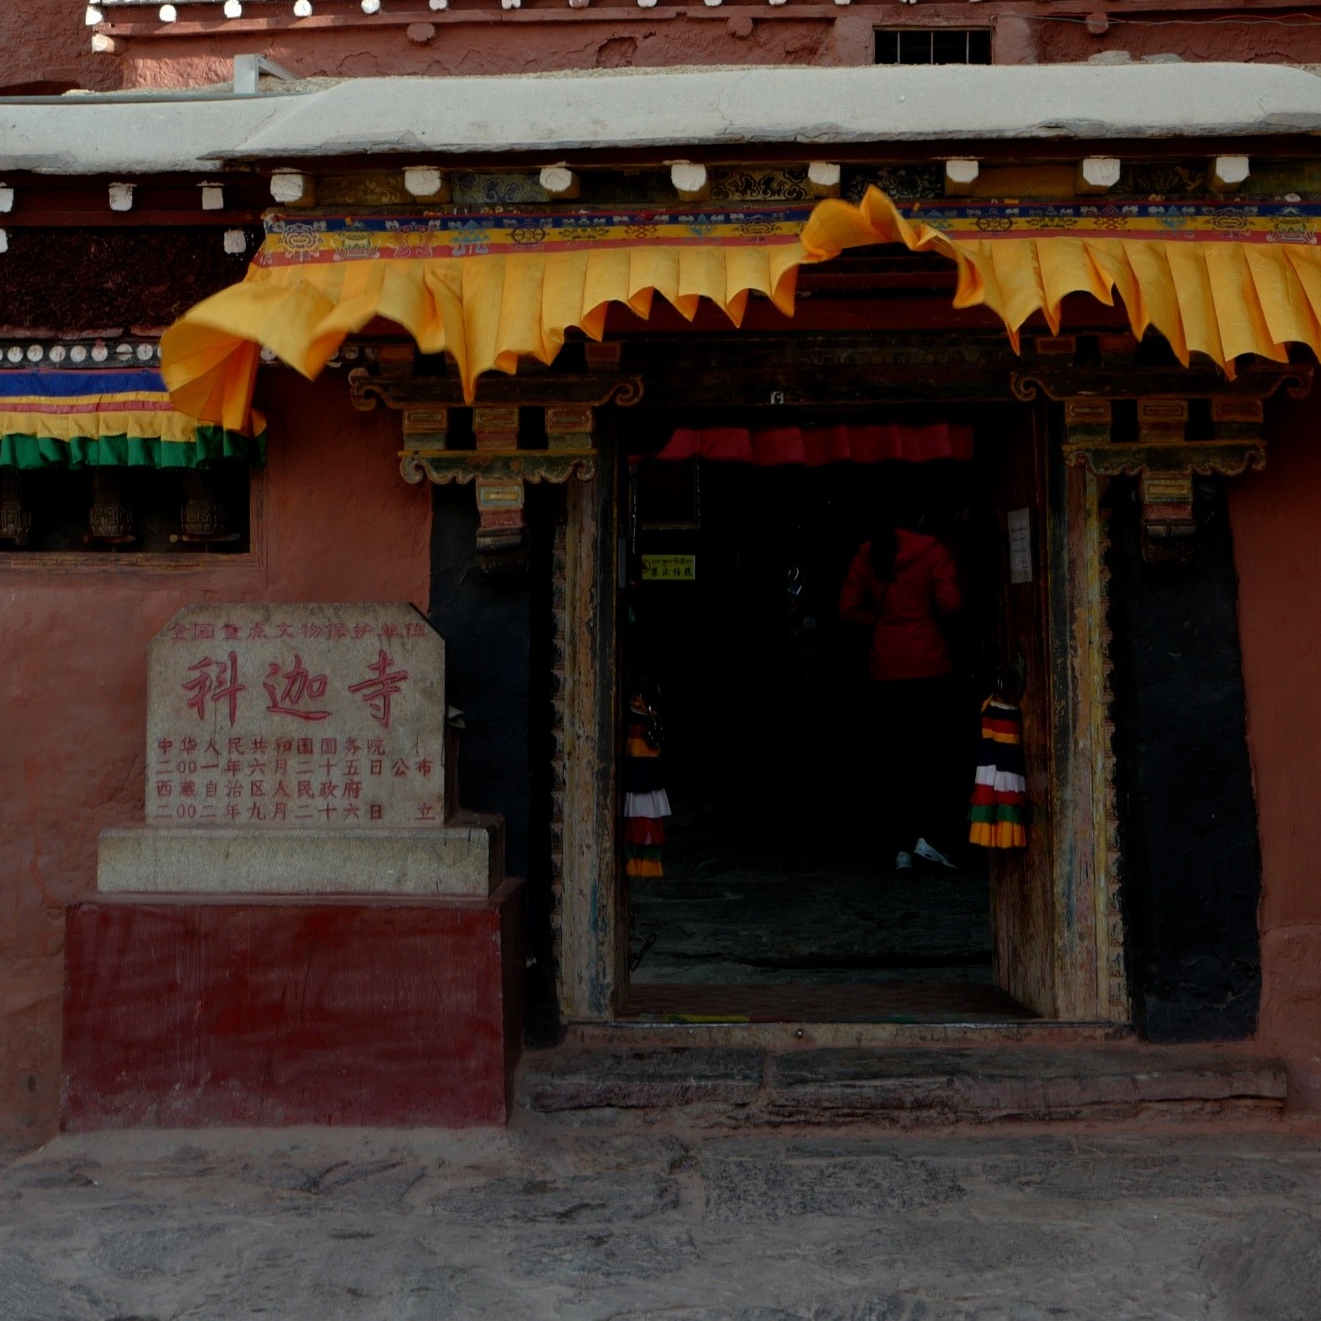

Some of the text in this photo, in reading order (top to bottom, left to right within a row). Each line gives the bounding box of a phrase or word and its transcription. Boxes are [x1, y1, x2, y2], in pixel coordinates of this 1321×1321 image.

[170, 622, 428, 640] 全国重点文物保护单位
[181, 648, 410, 729] 科迦寺
[157, 737, 386, 756] 中华人民共和国国务院
[156, 780, 363, 799] 西藏自治区人民政府
